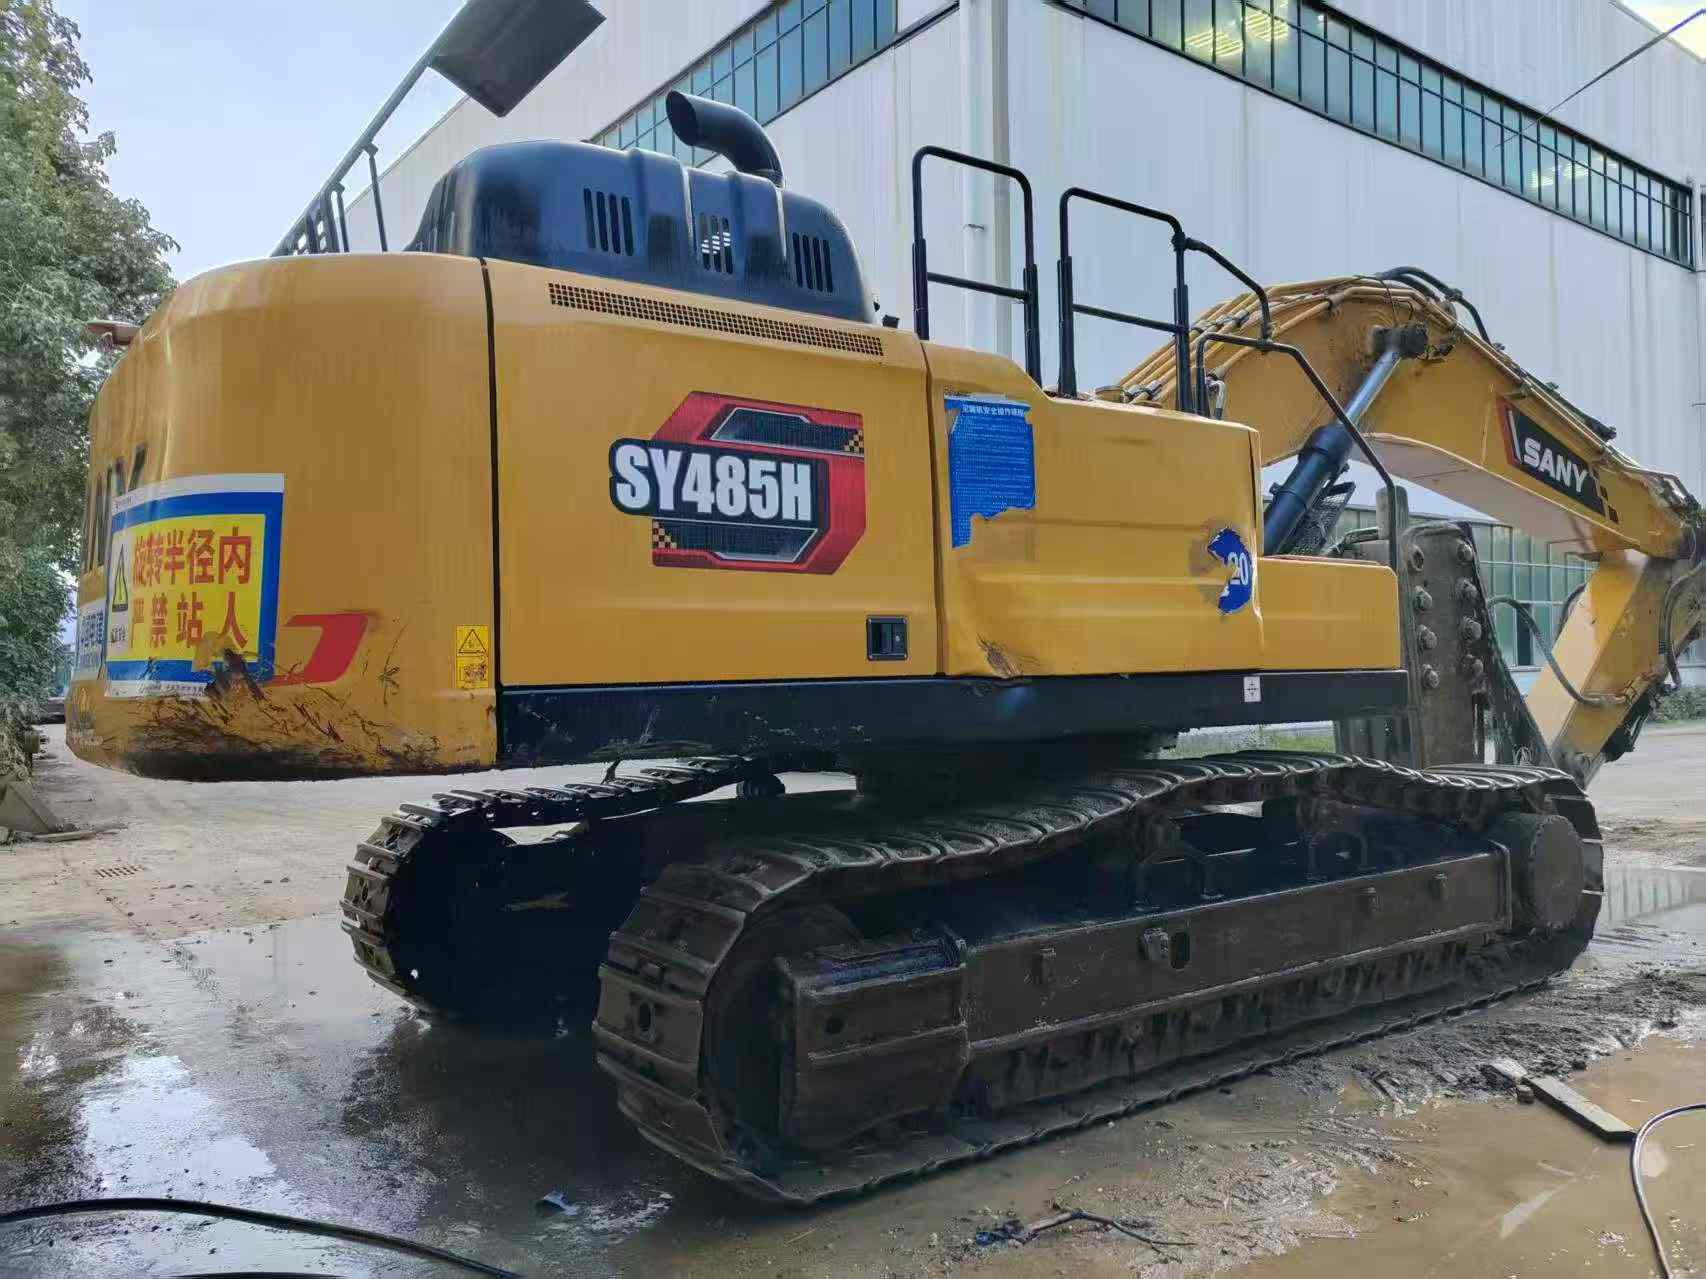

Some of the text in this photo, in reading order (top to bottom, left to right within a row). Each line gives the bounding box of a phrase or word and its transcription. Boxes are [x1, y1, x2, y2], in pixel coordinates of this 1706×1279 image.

[615, 444, 812, 521] SY485H
[1523, 437, 1589, 493] SANY
[133, 526, 253, 587] 旋转半径内
[130, 592, 248, 649] 严禁站人
